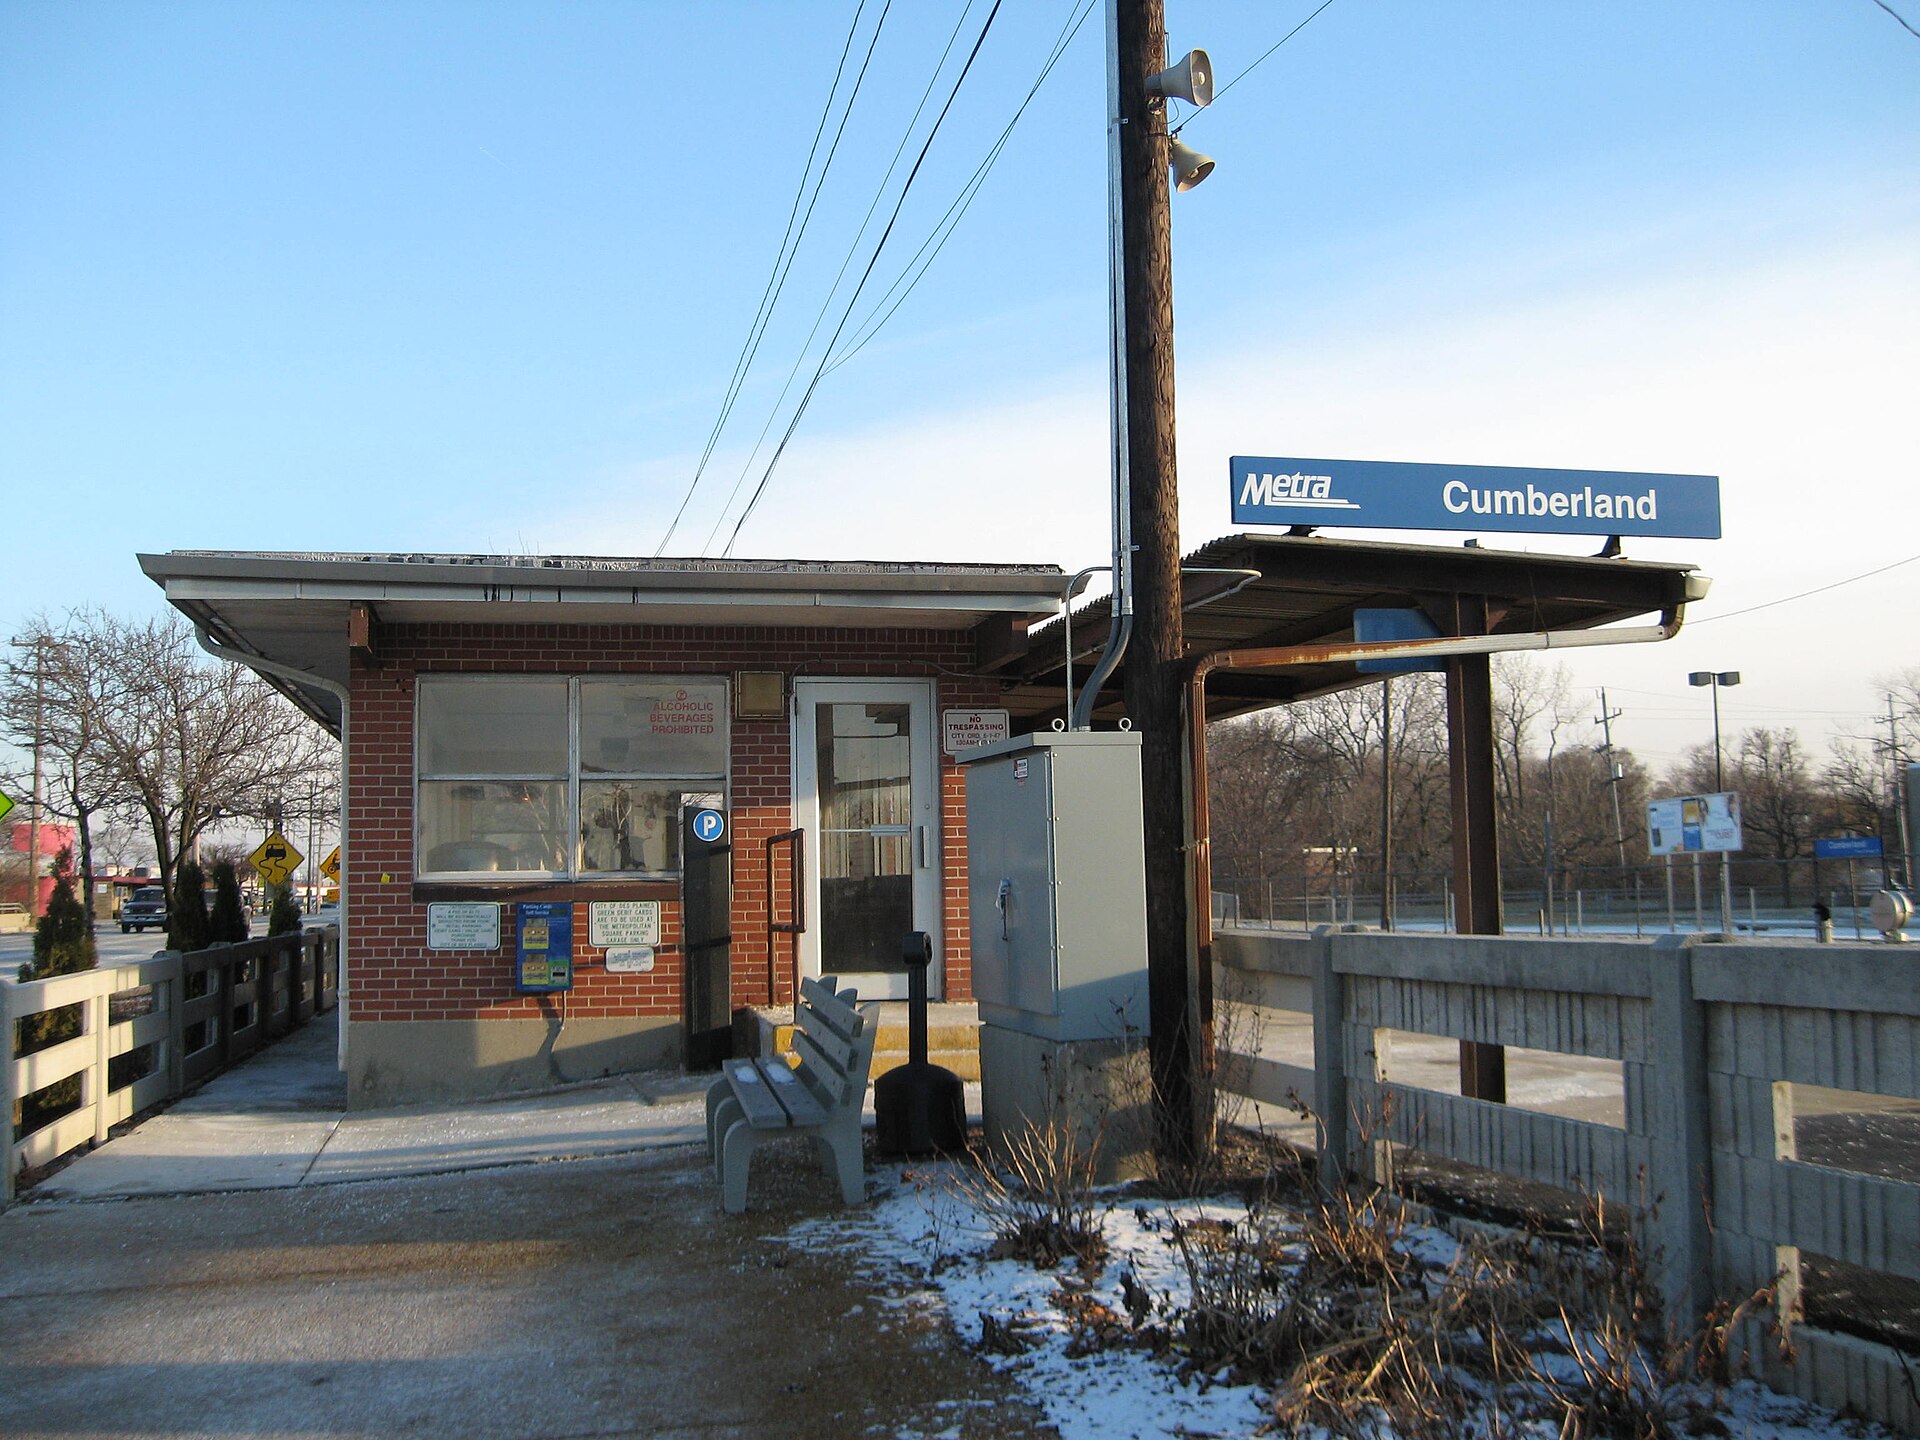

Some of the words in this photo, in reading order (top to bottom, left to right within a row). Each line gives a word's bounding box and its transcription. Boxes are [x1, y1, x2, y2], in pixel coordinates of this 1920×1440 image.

[1239, 471, 1333, 506] Metra
[1442, 480, 1657, 520] Cumberland
[653, 702, 714, 711] ALCOHOLIC
[650, 713, 714, 723] BEVERAGES
[652, 724, 714, 734] PROHIBITED
[704, 816, 716, 836] P
